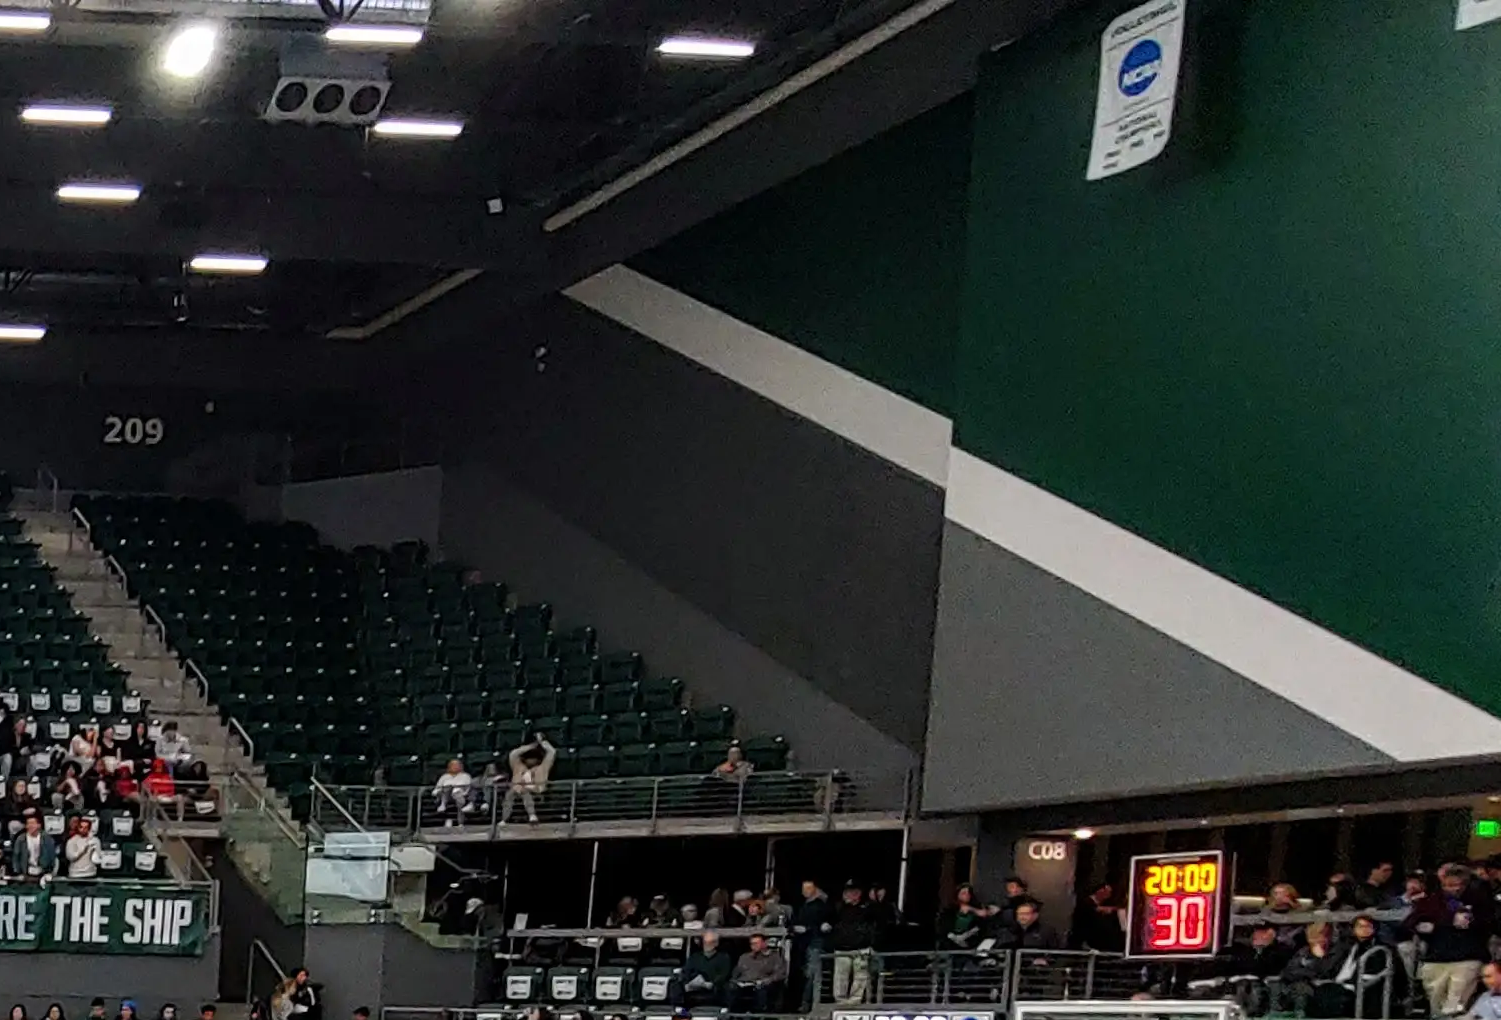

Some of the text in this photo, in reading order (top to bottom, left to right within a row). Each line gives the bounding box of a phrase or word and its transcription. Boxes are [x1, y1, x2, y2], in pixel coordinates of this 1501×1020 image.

[103, 416, 164, 445] 209
[1028, 841, 1067, 860] C08
[1145, 863, 1217, 895] 20:00
[49, 895, 111, 944] THE
[122, 897, 193, 945] SHIP
[1152, 896, 1208, 947] 30
